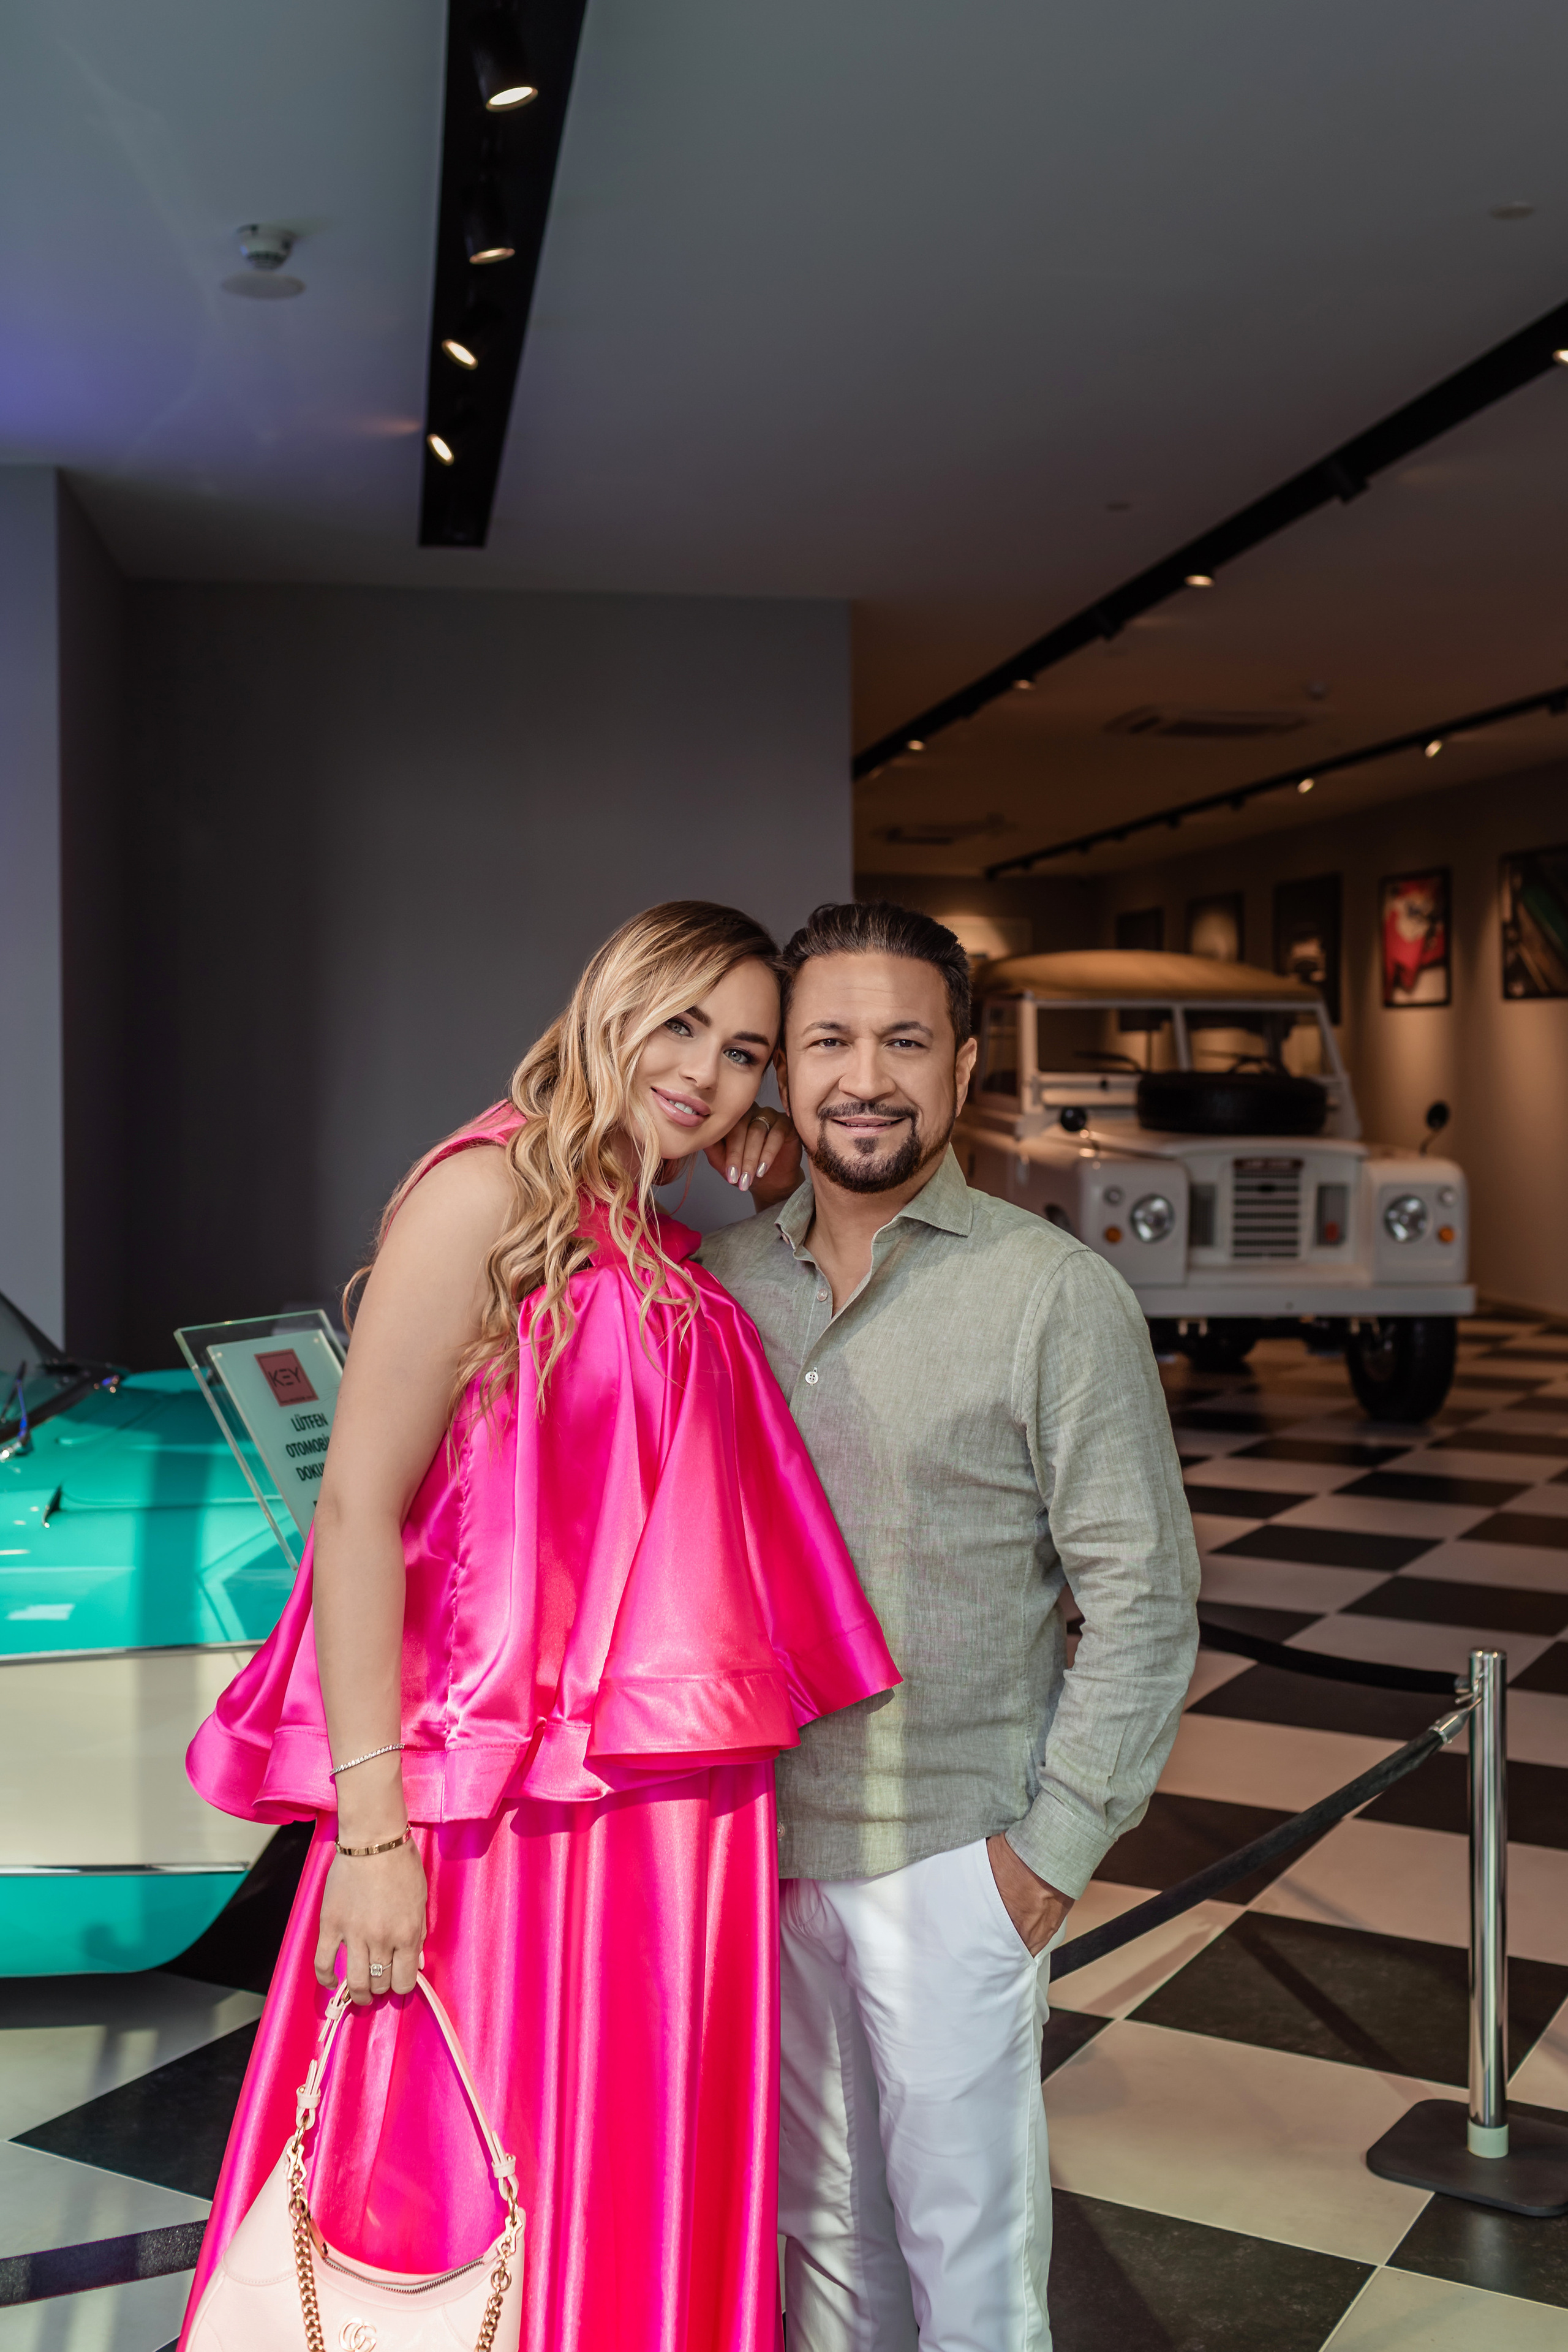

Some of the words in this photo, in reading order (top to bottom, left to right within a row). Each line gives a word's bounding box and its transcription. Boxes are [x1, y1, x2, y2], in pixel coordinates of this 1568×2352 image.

[268, 1366, 301, 1387] KEY
[290, 1412, 328, 1431] LÜTFEN
[296, 1462, 325, 1481] DOKU
